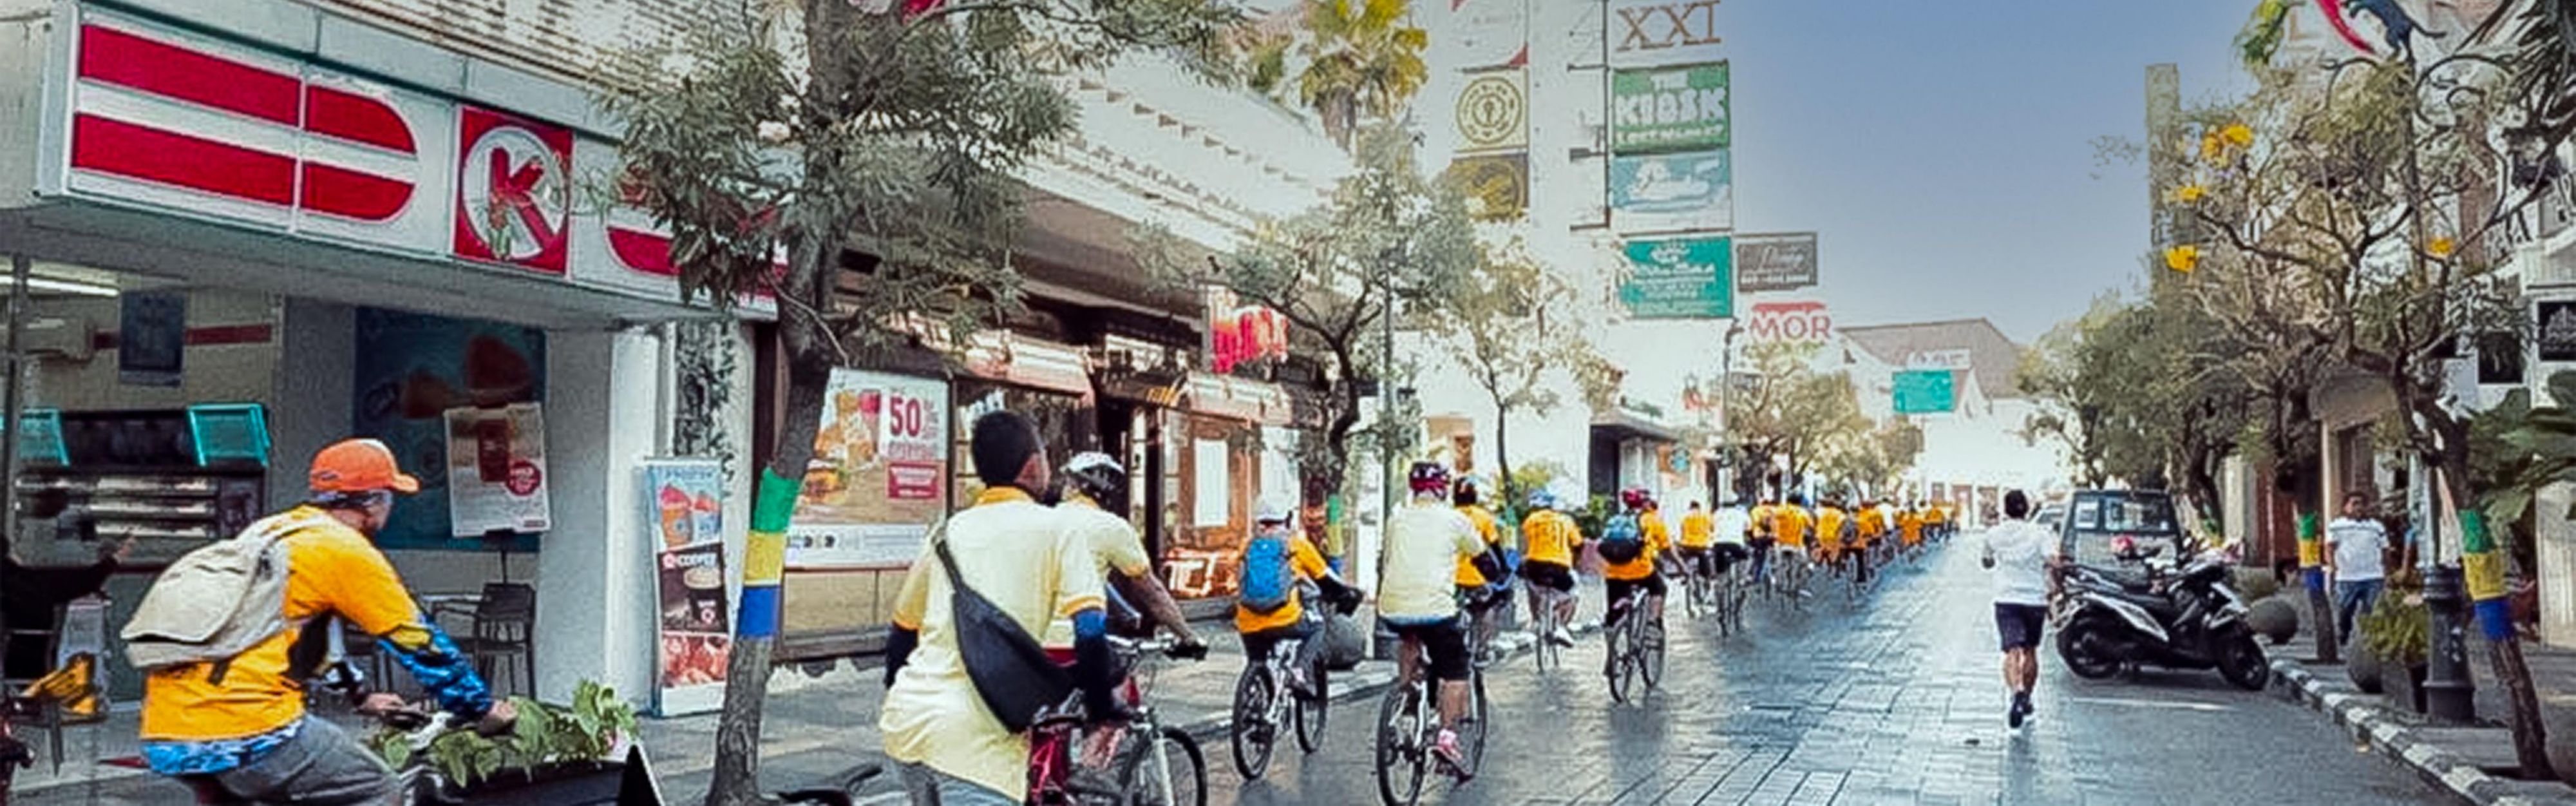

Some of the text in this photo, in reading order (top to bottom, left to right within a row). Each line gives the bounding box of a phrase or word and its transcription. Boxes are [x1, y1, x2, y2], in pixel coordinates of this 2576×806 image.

[1615, 0, 1721, 53] XXI
[1615, 87, 1726, 126] KIOSK
[488, 145, 560, 259] K
[1750, 314, 1831, 343] MOR
[889, 396, 921, 438] 50
